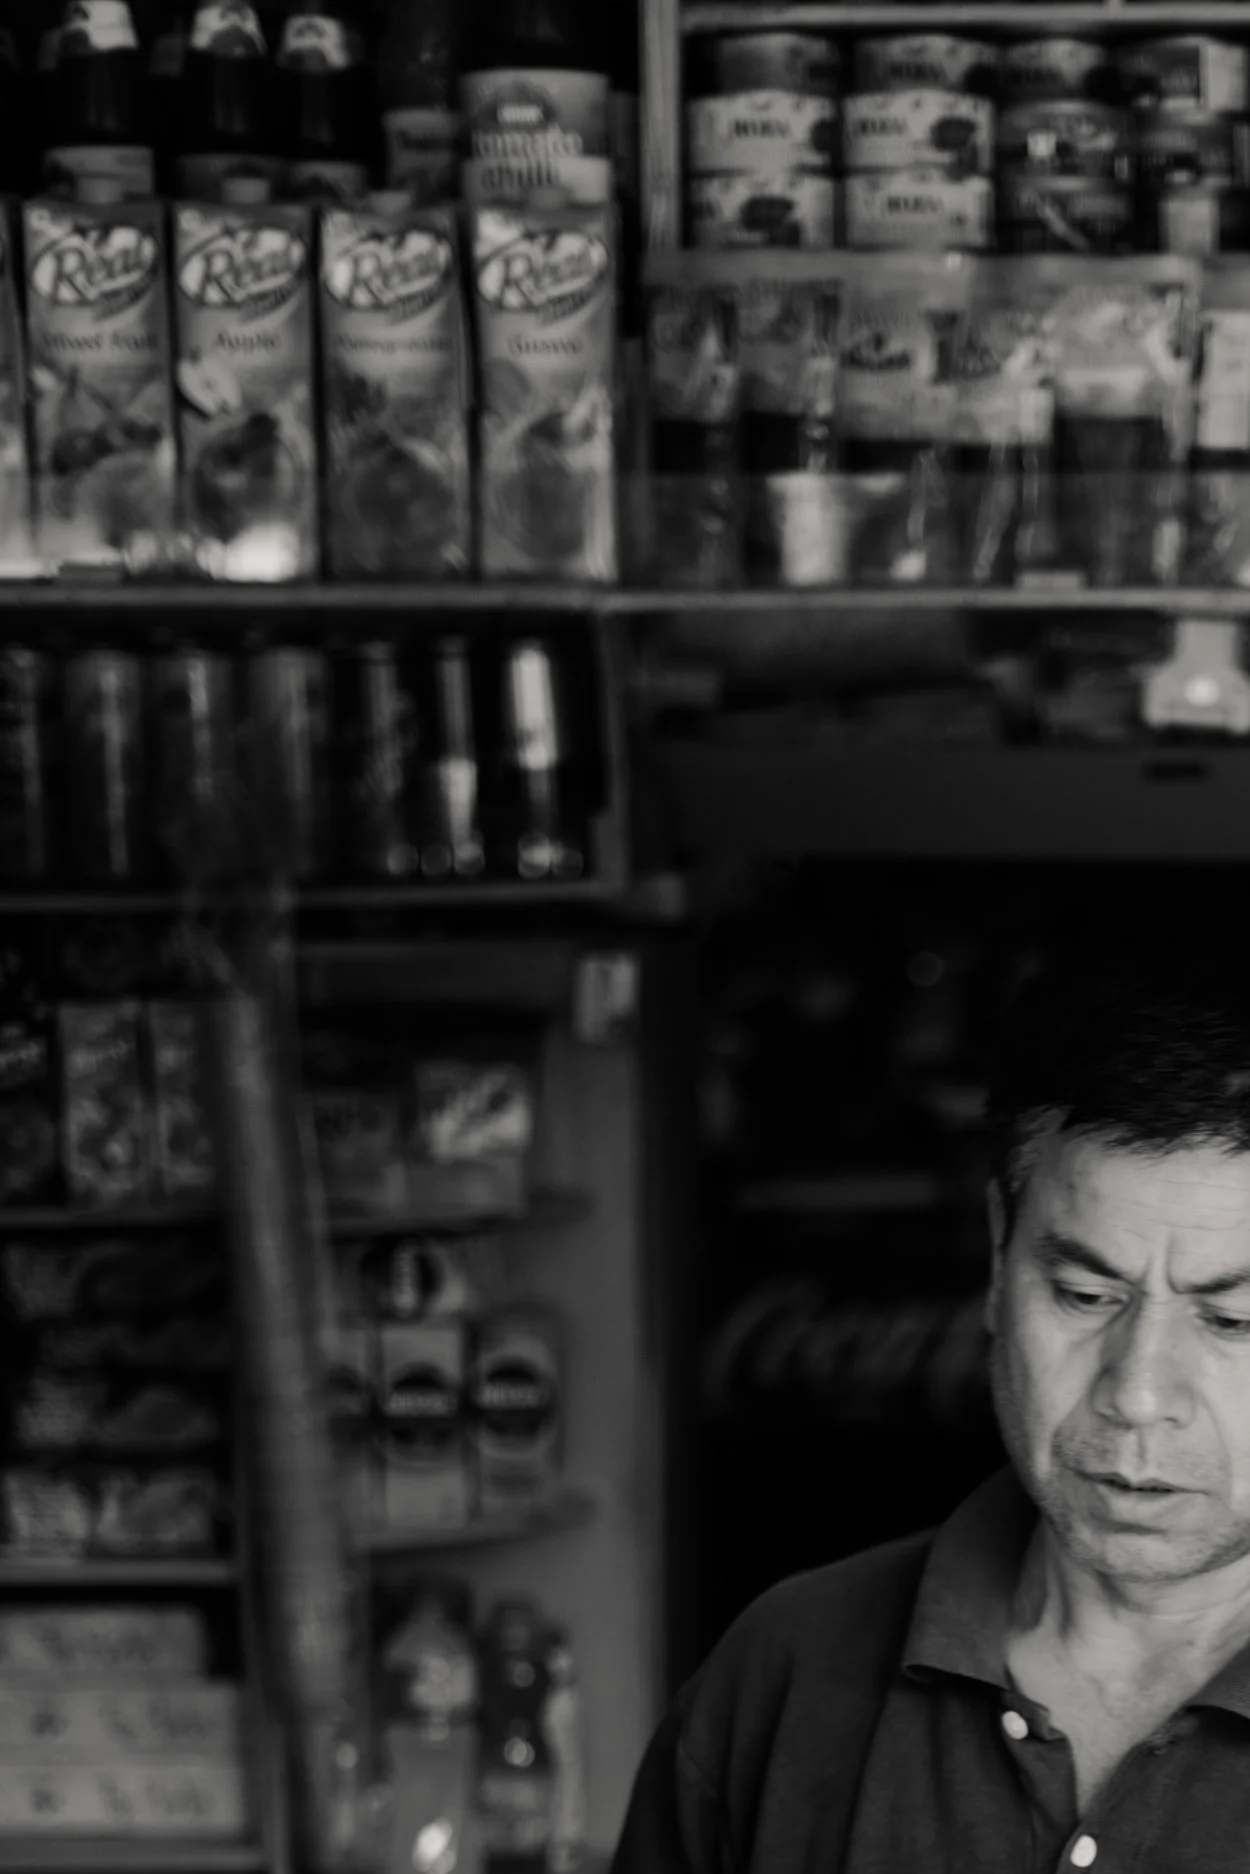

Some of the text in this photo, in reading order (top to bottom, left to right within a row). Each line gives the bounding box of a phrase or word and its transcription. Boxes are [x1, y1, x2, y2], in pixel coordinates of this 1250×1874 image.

[51, 230, 150, 305] Real
[198, 233, 297, 305] Real
[348, 234, 445, 306] Real
[498, 234, 600, 307] Real
